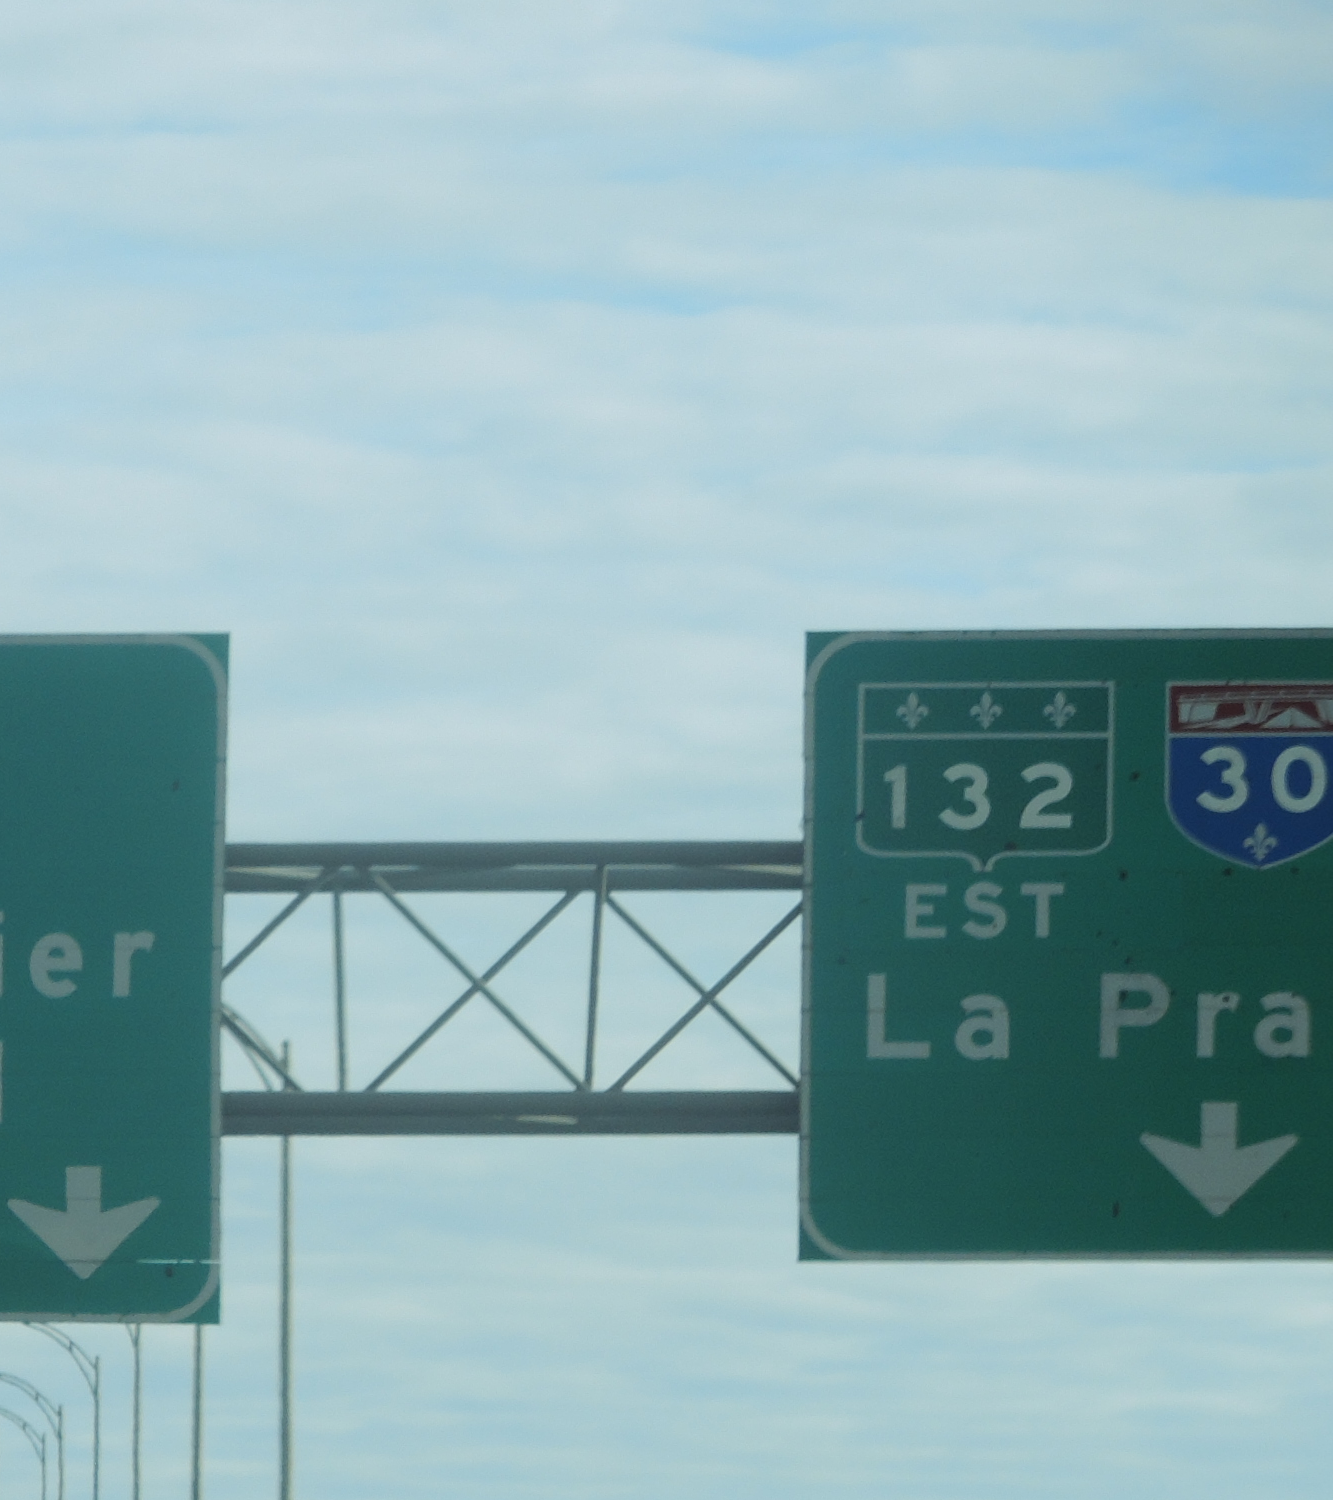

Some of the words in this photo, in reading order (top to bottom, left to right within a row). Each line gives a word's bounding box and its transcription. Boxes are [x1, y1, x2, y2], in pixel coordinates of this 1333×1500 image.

[884, 763, 1073, 830] 132
[1196, 745, 1329, 814] 30
[904, 881, 1065, 939] EST
[866, 973, 1010, 1060] La
[1099, 973, 1312, 1060] Pra
